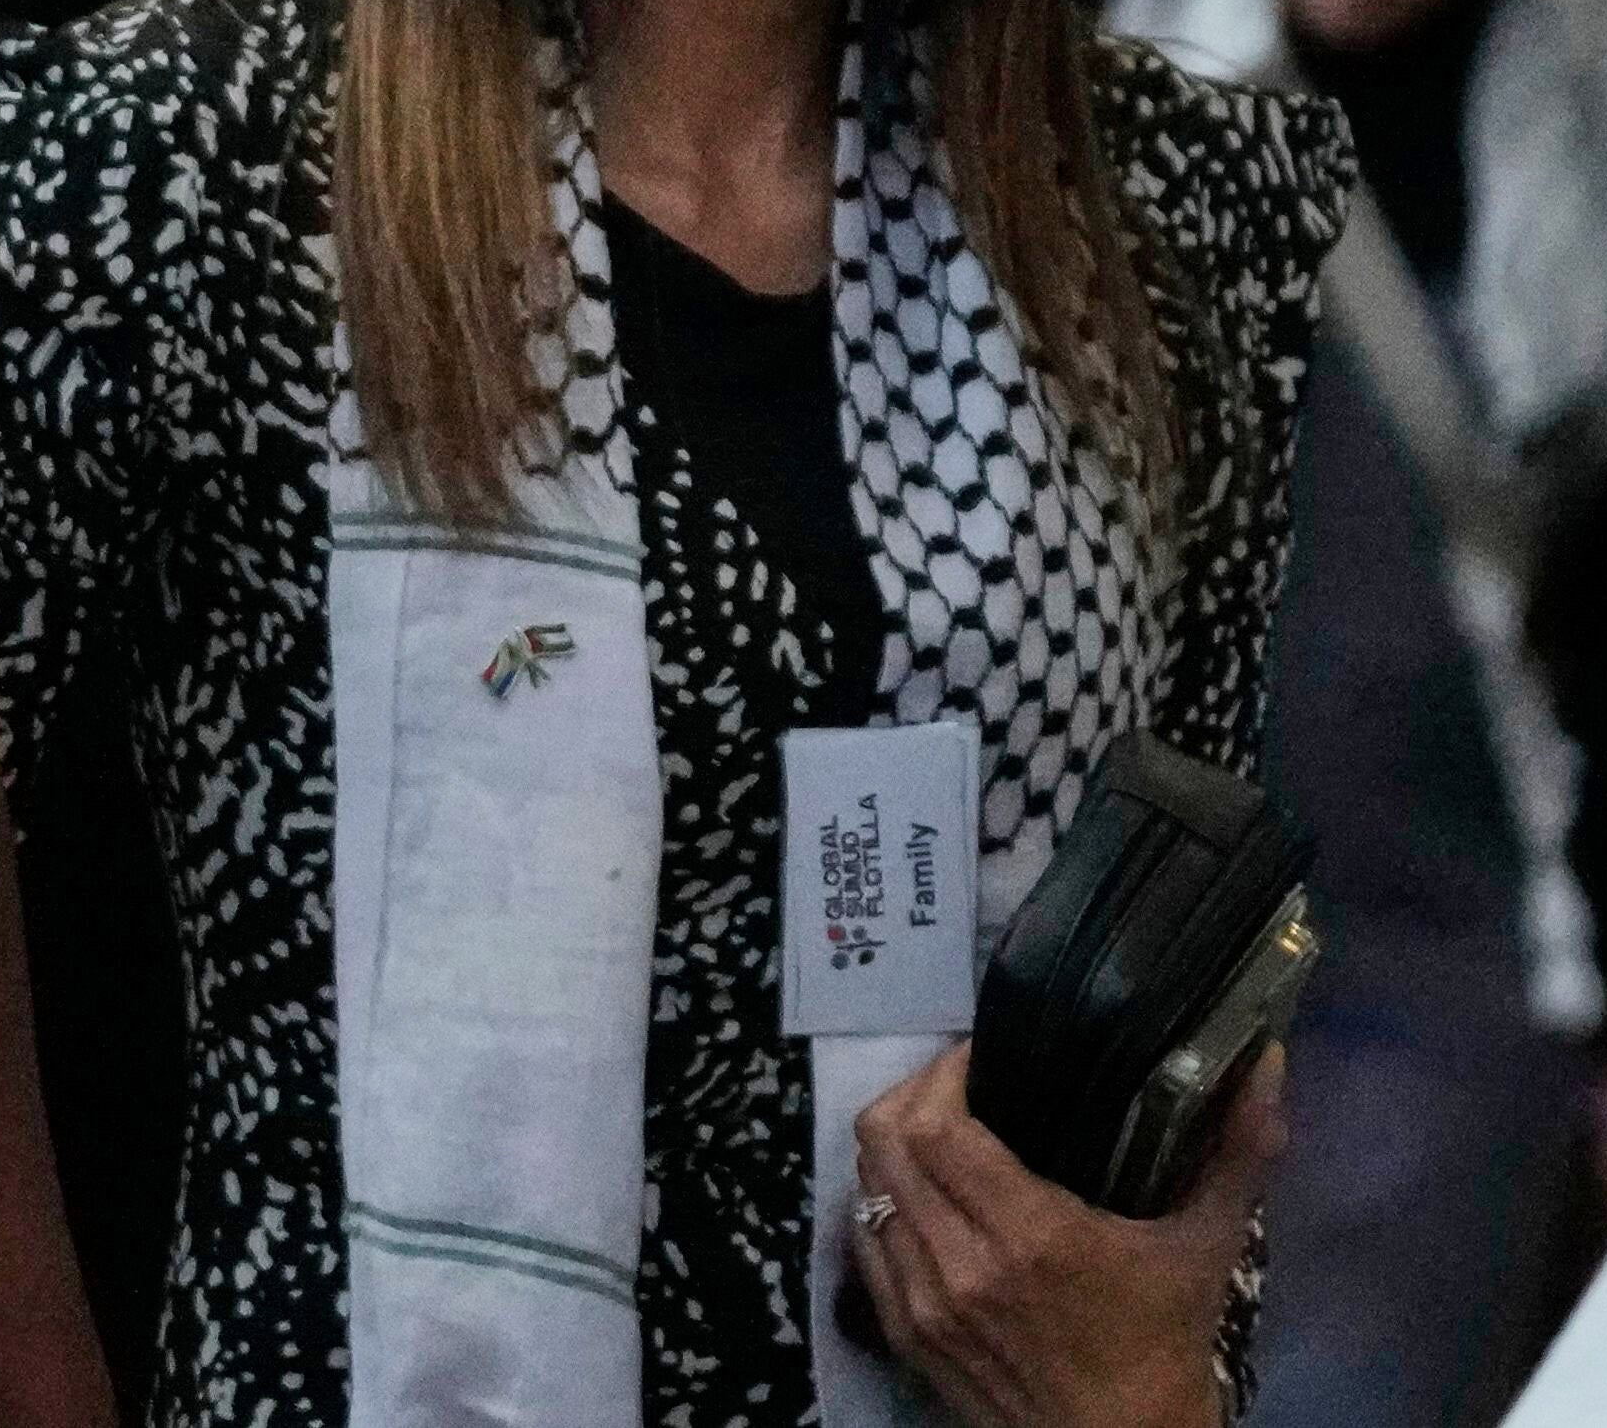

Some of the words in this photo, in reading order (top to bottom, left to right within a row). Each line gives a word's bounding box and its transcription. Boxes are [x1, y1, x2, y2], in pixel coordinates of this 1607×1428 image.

[819, 814, 845, 920] GLOBAL
[858, 793, 884, 918] FLOTILLA
[906, 822, 939, 928] Family
